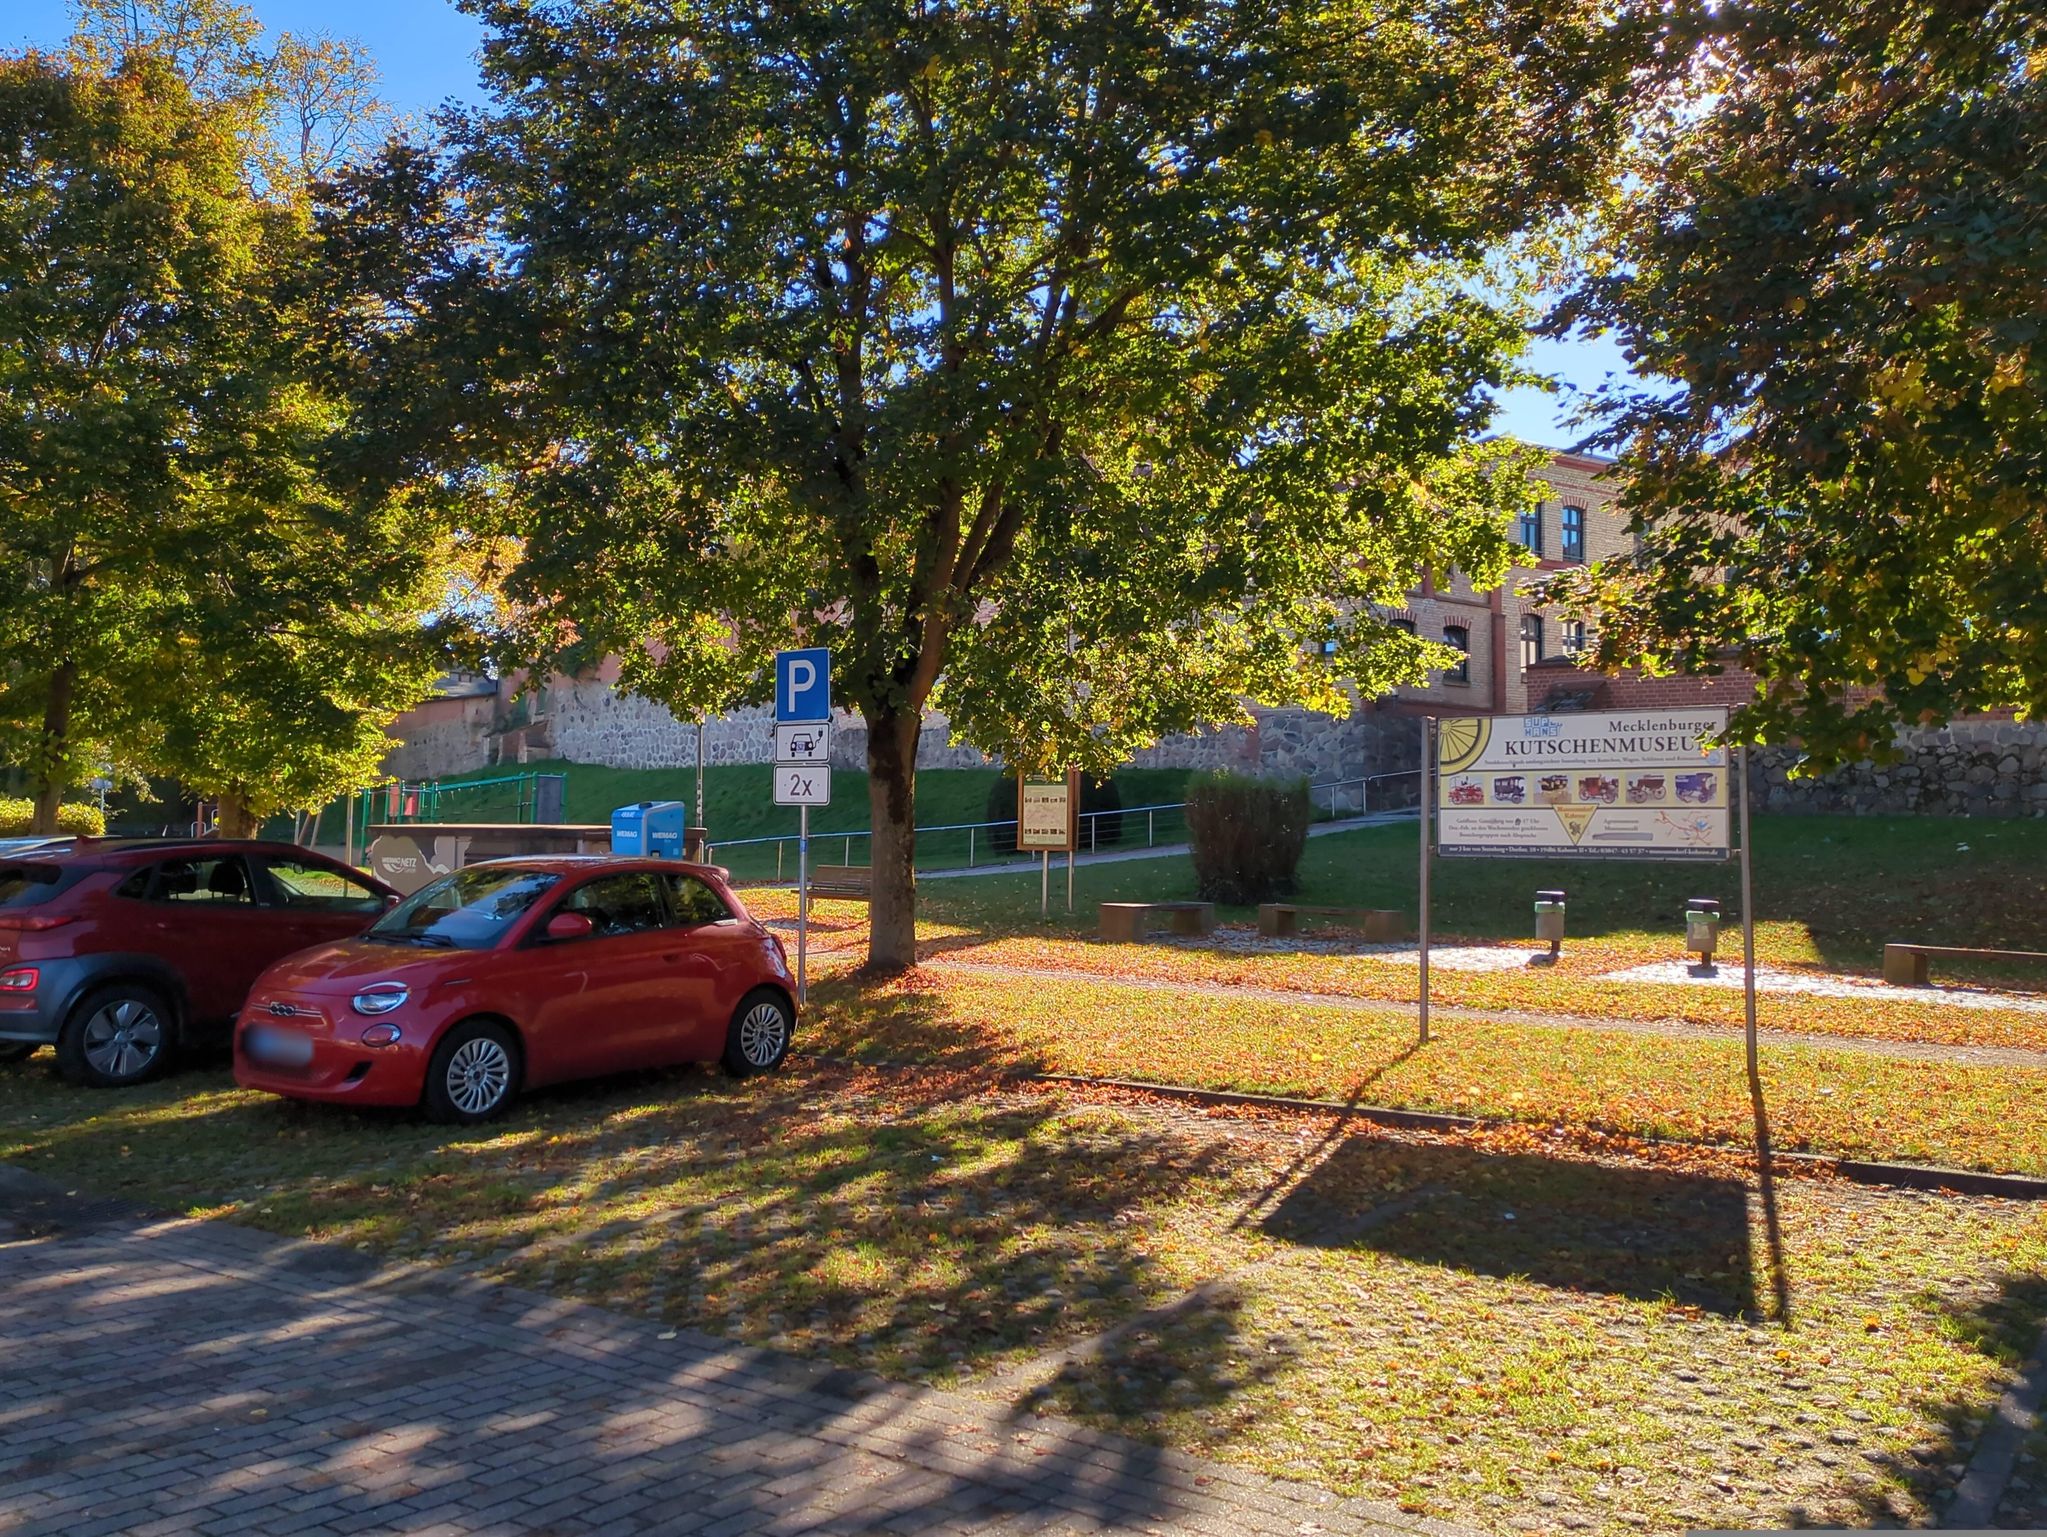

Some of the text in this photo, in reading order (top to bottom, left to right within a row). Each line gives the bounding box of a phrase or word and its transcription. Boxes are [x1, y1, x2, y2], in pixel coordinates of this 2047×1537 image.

[788, 659, 816, 713] P
[1609, 719, 1717, 734] Mecklenburger
[790, 773, 813, 797] 2x
